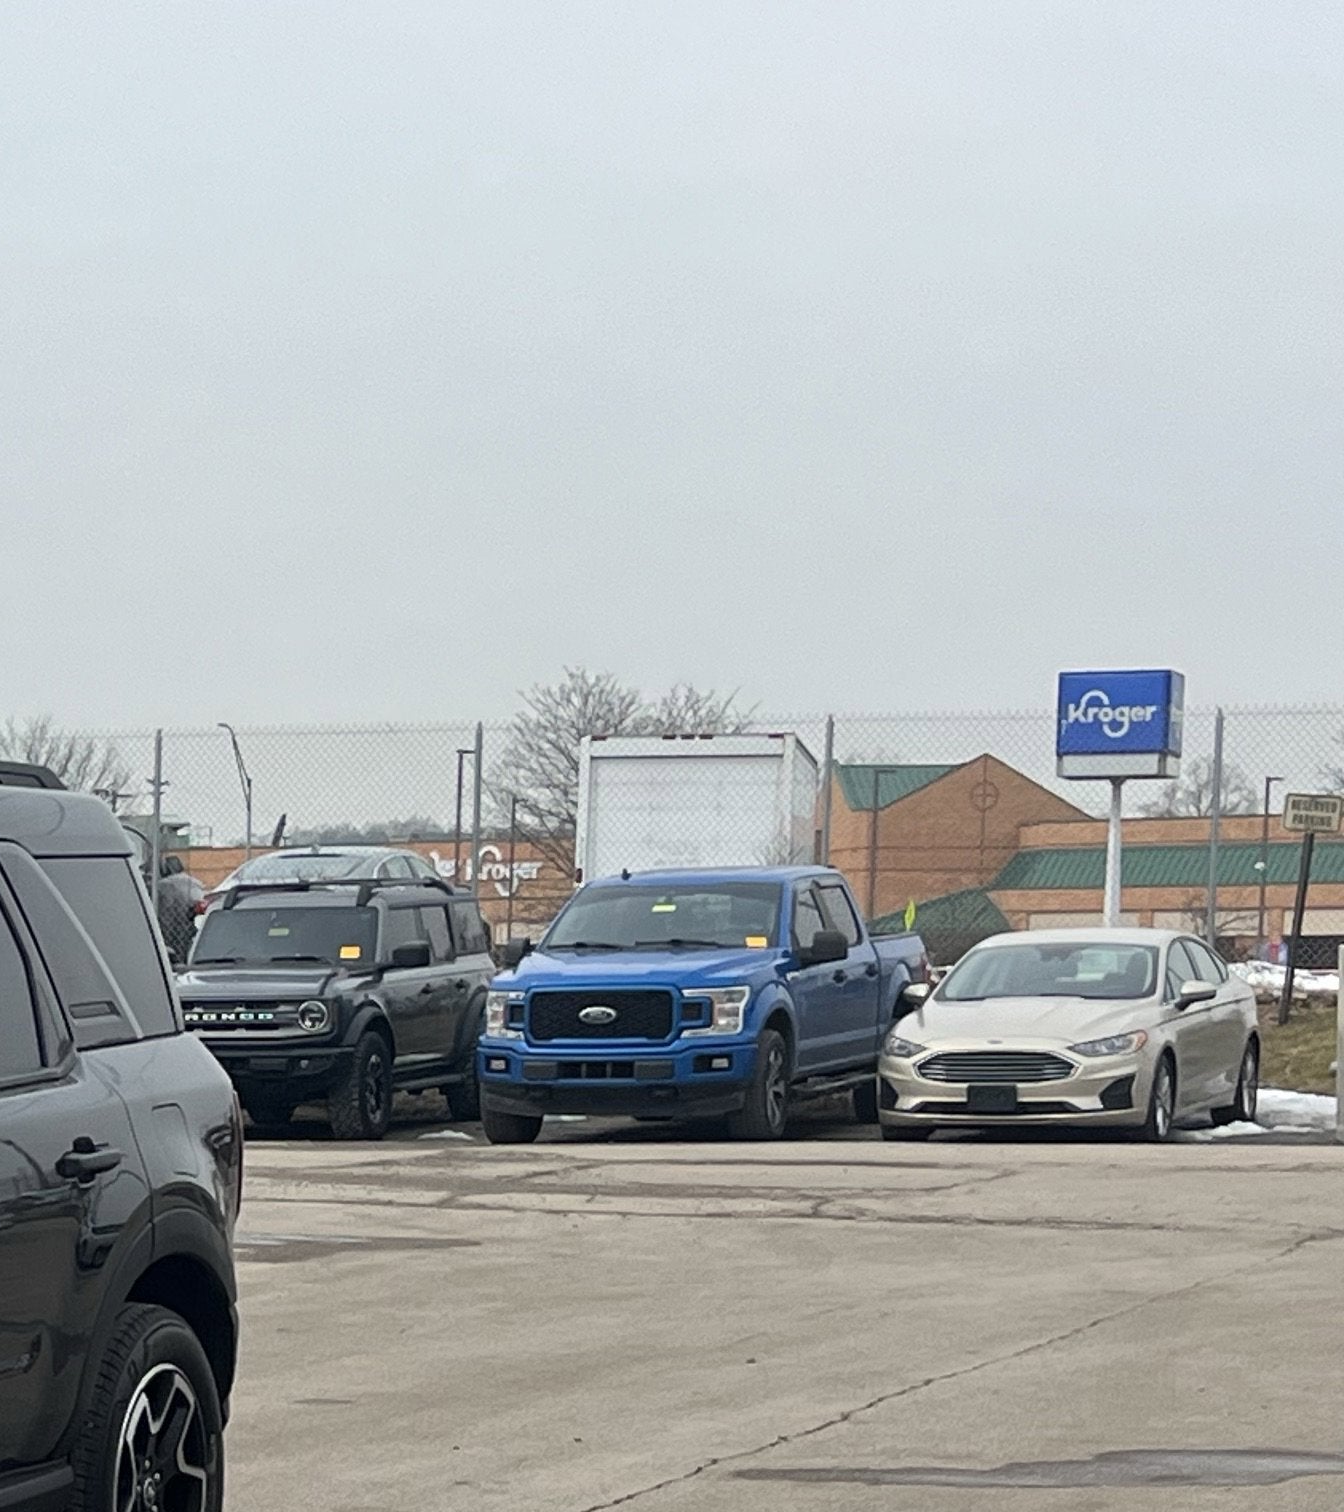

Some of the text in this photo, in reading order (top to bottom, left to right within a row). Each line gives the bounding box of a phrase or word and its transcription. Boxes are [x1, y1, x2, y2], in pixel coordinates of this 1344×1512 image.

[1067, 689, 1157, 738] Kroger
[1291, 799, 1337, 813] RESERVED
[184, 1013, 274, 1021] RONCO
